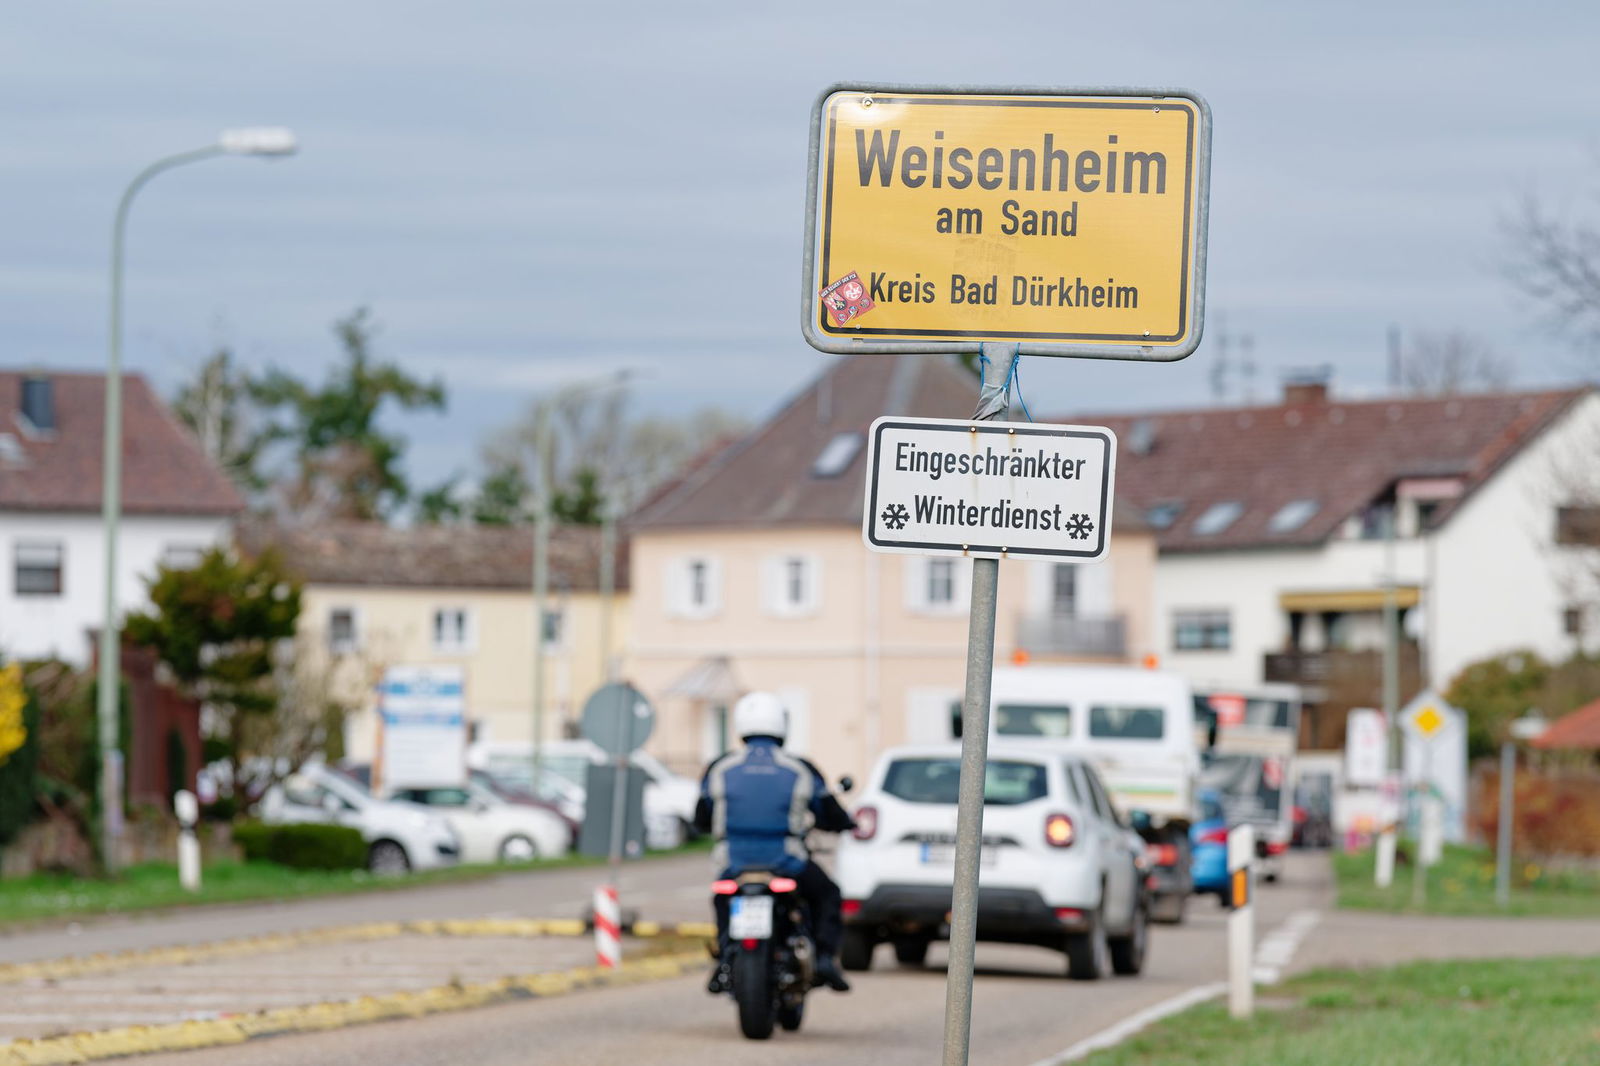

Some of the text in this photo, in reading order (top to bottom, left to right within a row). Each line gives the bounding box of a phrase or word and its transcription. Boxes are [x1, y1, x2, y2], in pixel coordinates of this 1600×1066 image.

[855, 129, 1167, 194] Weisenheim
[936, 200, 1078, 237] am Sand
[870, 272, 935, 304] Kreis
[951, 274, 998, 306] Bad
[1012, 276, 1138, 308] Dürkheim
[895, 442, 1086, 480] Eingeschränkter
[914, 494, 1062, 531] Winterdienst
